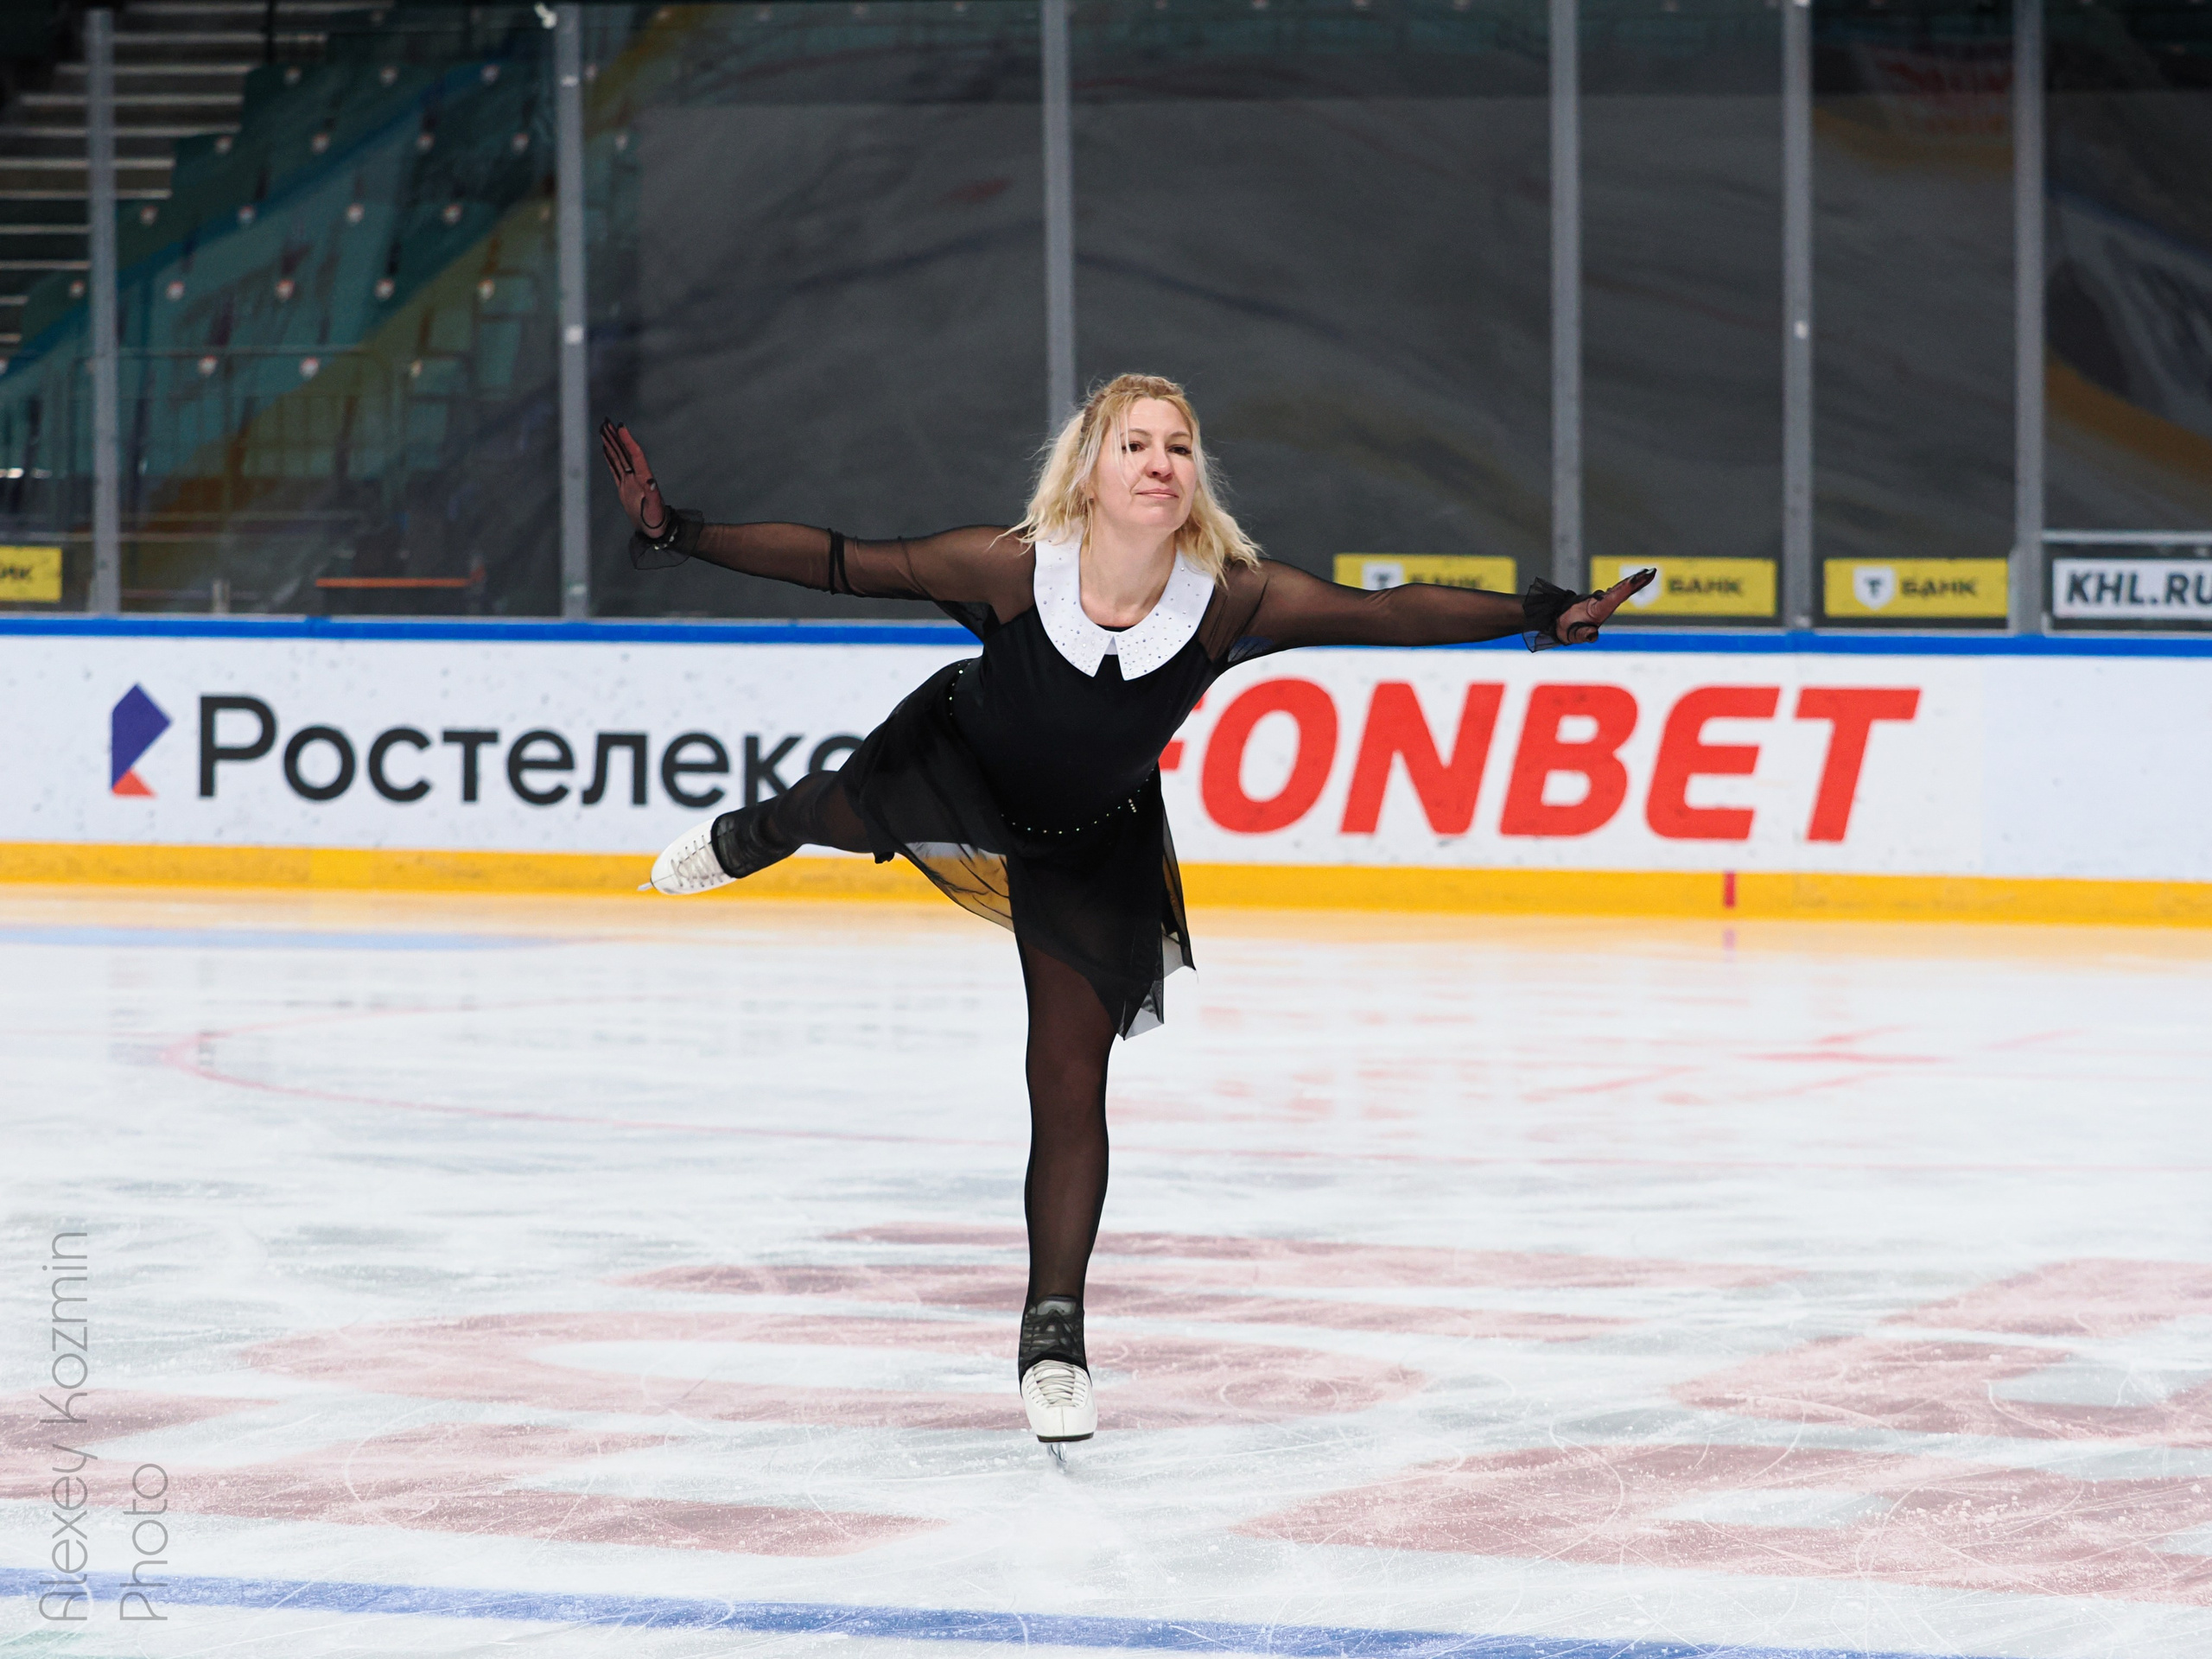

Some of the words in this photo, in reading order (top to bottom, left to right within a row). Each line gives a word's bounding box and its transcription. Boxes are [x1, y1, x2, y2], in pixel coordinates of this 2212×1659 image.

[1903, 578, 1976, 597] БАНК
[2067, 572, 2212, 604] KHL.RU
[1159, 677, 1920, 842] ONBET
